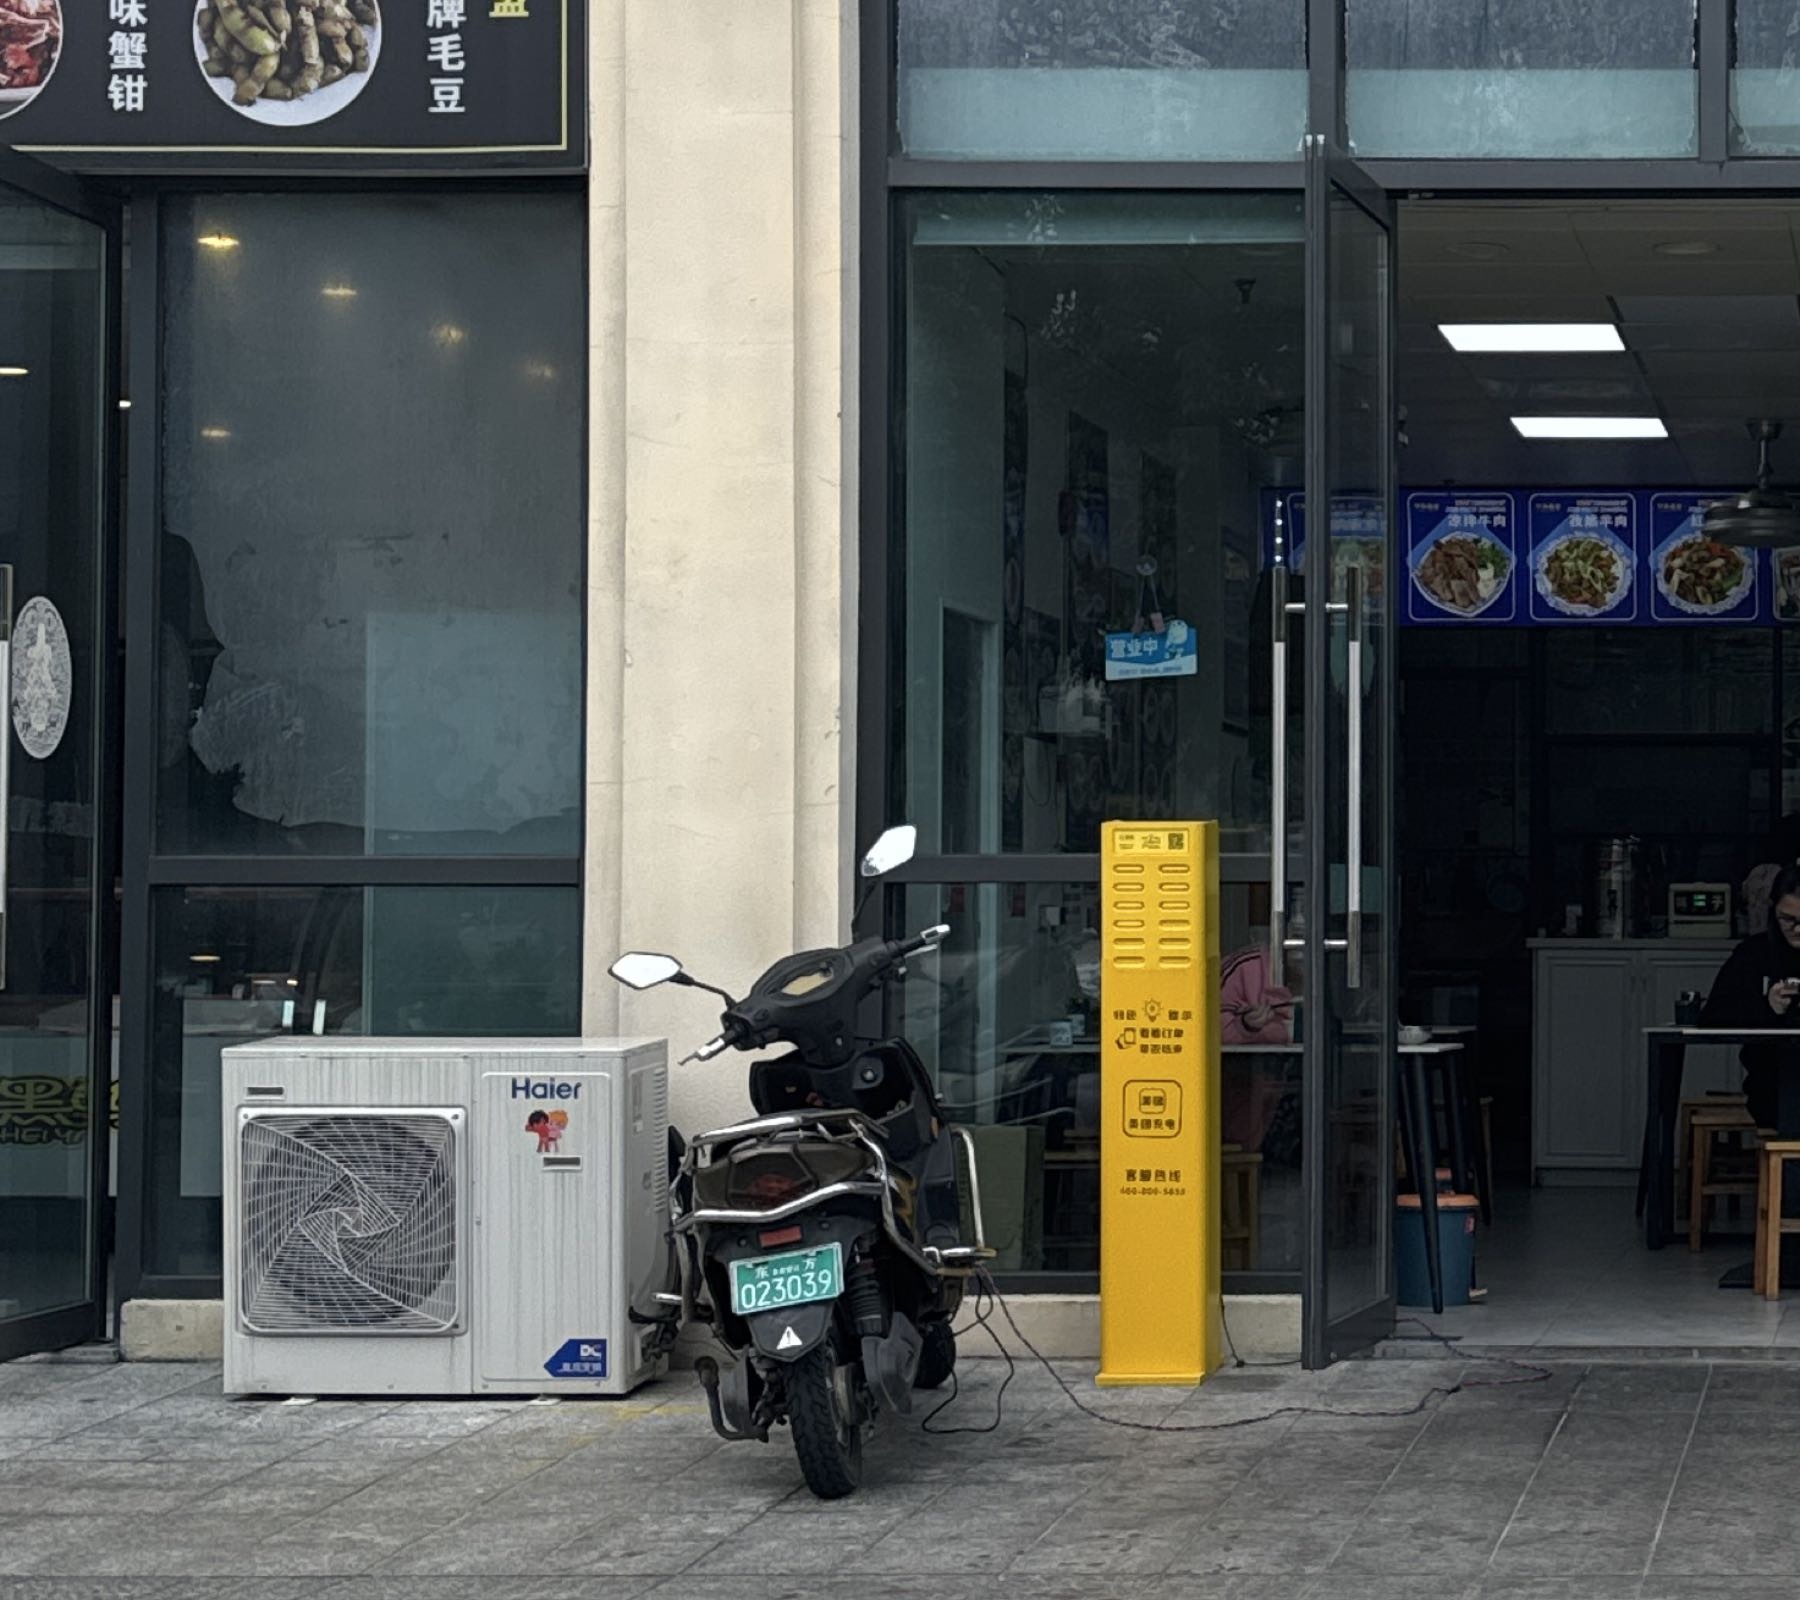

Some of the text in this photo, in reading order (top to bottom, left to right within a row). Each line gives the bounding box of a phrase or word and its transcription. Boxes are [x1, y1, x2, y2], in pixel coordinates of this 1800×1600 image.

[1110, 637, 1159, 659] 营业中
[511, 1076, 583, 1101] Haier
[740, 1268, 832, 1309] 023039
